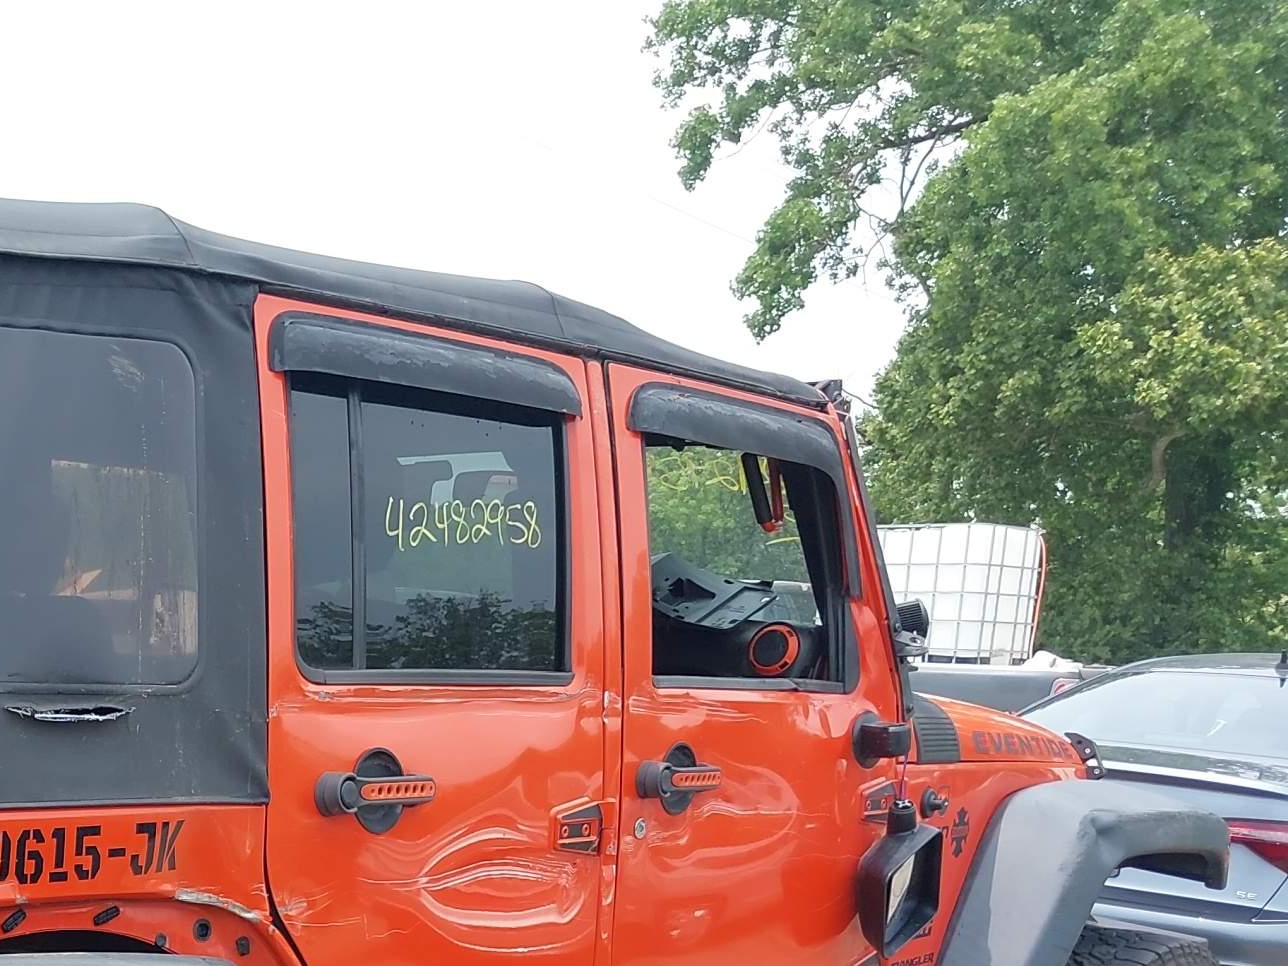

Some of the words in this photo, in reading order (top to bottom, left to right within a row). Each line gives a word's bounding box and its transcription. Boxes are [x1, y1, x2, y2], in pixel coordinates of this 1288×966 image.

[385, 496, 541, 552] 42482958
[972, 730, 1073, 759] EVENTIDE
[1236, 890, 1258, 901] SE
